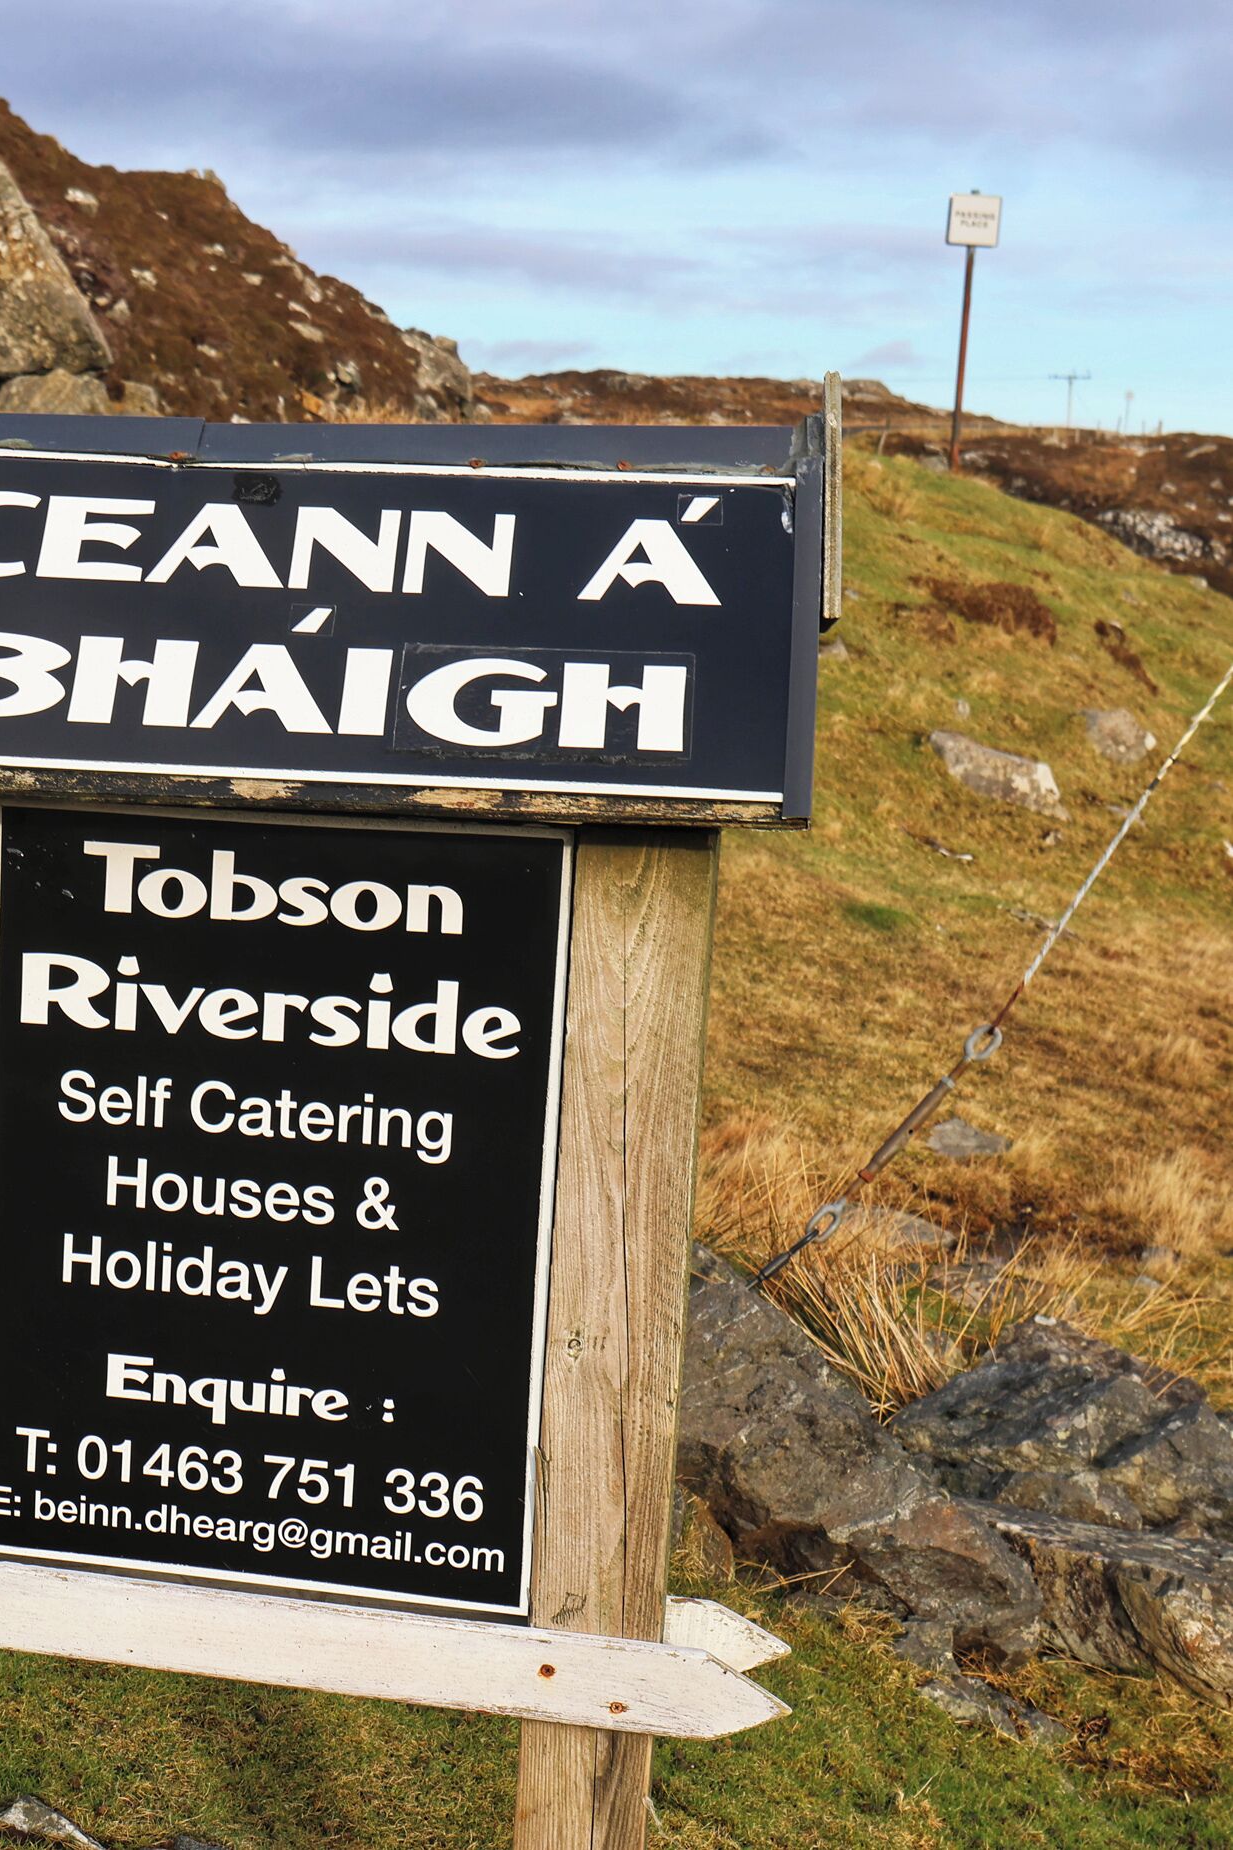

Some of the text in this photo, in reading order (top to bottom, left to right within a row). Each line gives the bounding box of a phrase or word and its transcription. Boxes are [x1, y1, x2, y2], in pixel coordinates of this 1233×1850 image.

[576, 496, 722, 606] Á
[83, 840, 464, 935] Tobson
[20, 952, 522, 1059] Riverside
[57, 1069, 453, 1165] Self Catering
[106, 1155, 400, 1231] Houses &
[62, 1232, 439, 1318] Holiday Lets
[105, 1353, 349, 1425] Enquire
[15, 1426, 484, 1522] T: 01463 751 336
[34, 1489, 505, 1573] beinn.dhearg@gmail.com
